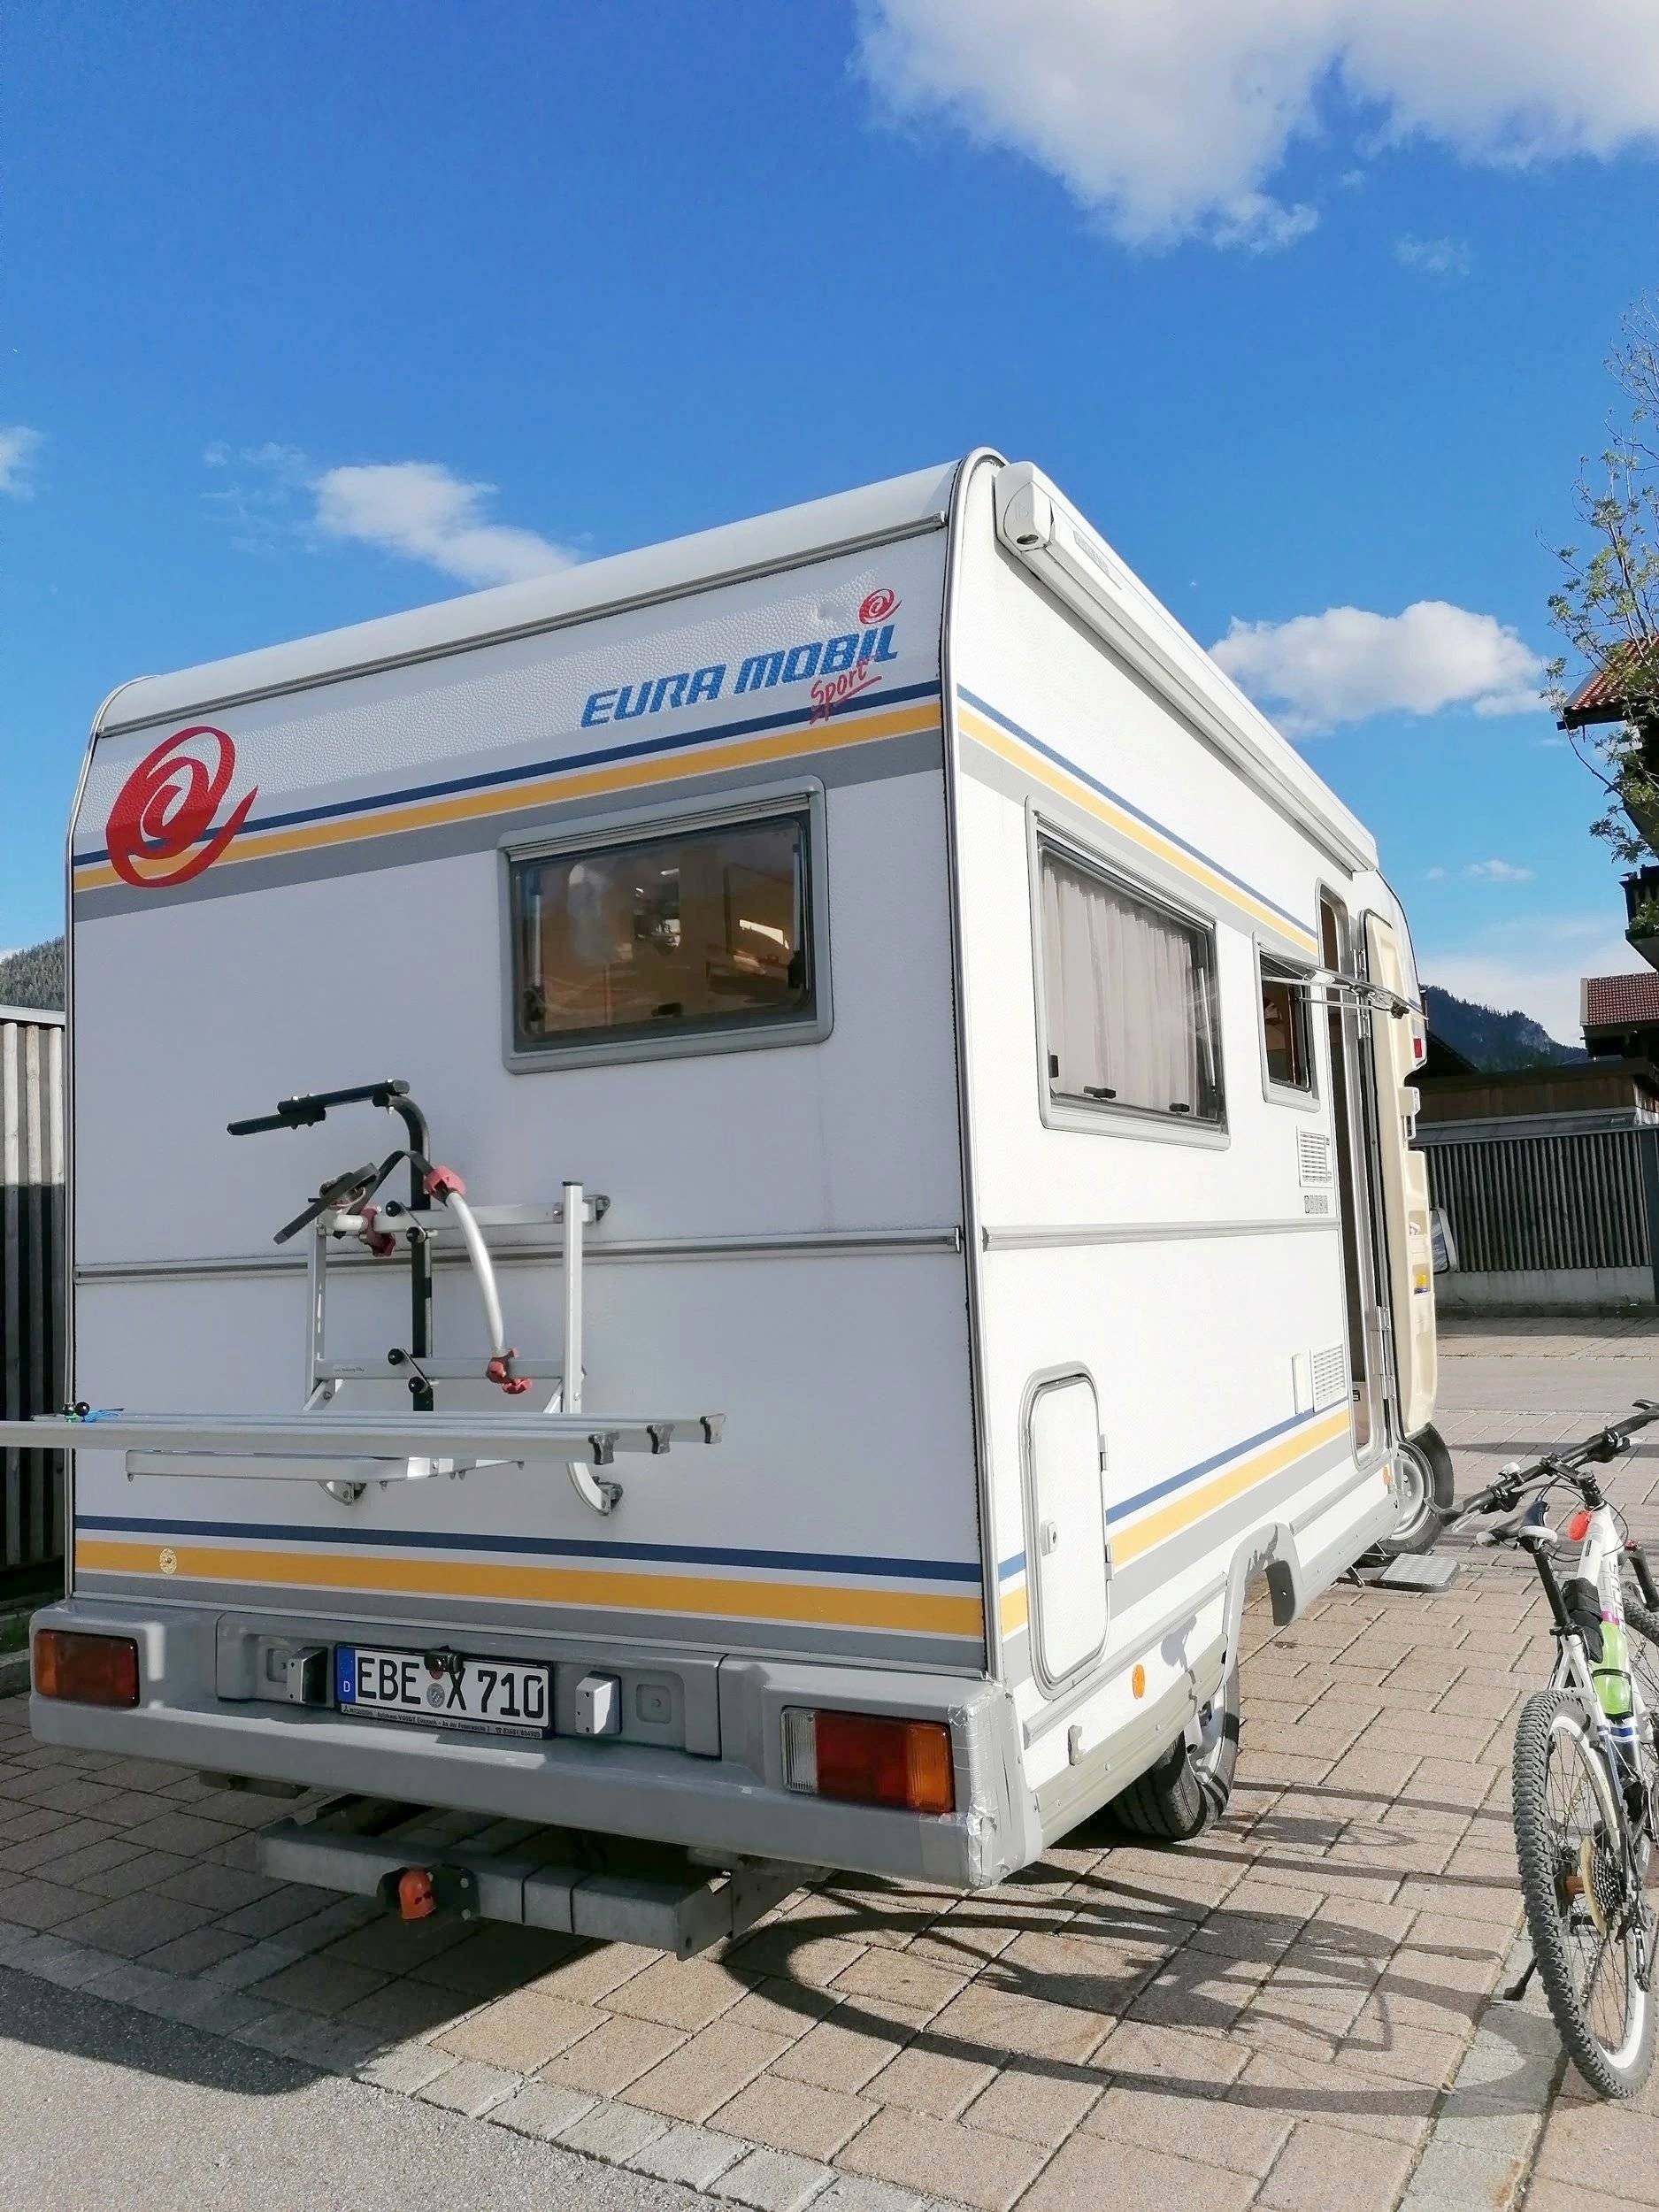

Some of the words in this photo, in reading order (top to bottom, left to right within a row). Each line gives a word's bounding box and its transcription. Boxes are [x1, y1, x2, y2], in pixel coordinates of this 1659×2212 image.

[581, 664, 726, 727] EURA
[734, 625, 898, 694] MOBIL
[810, 657, 872, 725] Sport
[342, 1680, 350, 1693] D
[357, 1657, 420, 1704] EBE
[446, 1667, 467, 1711] X
[479, 1670, 543, 1718] 710
